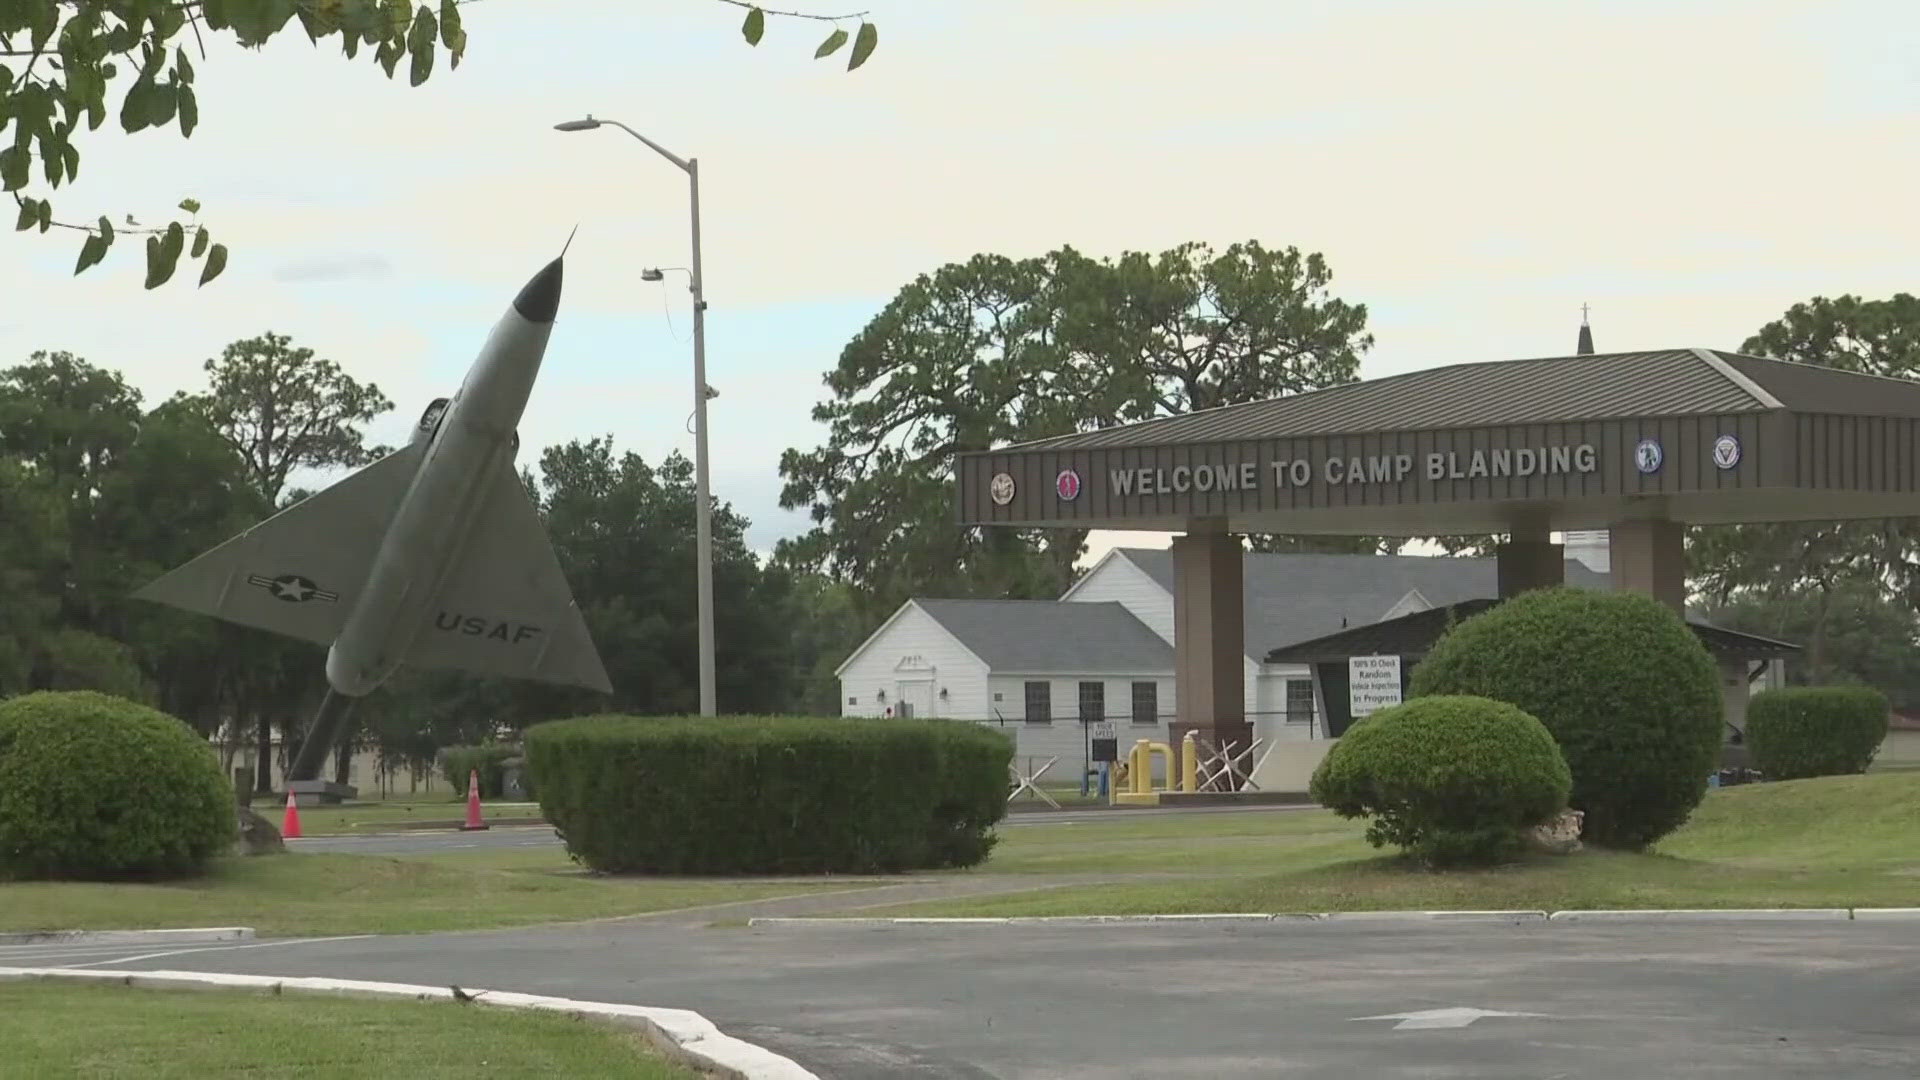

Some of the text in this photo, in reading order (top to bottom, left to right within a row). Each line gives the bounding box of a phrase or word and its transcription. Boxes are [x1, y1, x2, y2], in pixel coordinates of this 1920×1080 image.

[1110, 444, 1597, 496] WELCOME TO CAMP BLANDING
[436, 612, 542, 644] USAF
[1359, 670, 1391, 679] Random
[1354, 694, 1398, 704] In Progress
